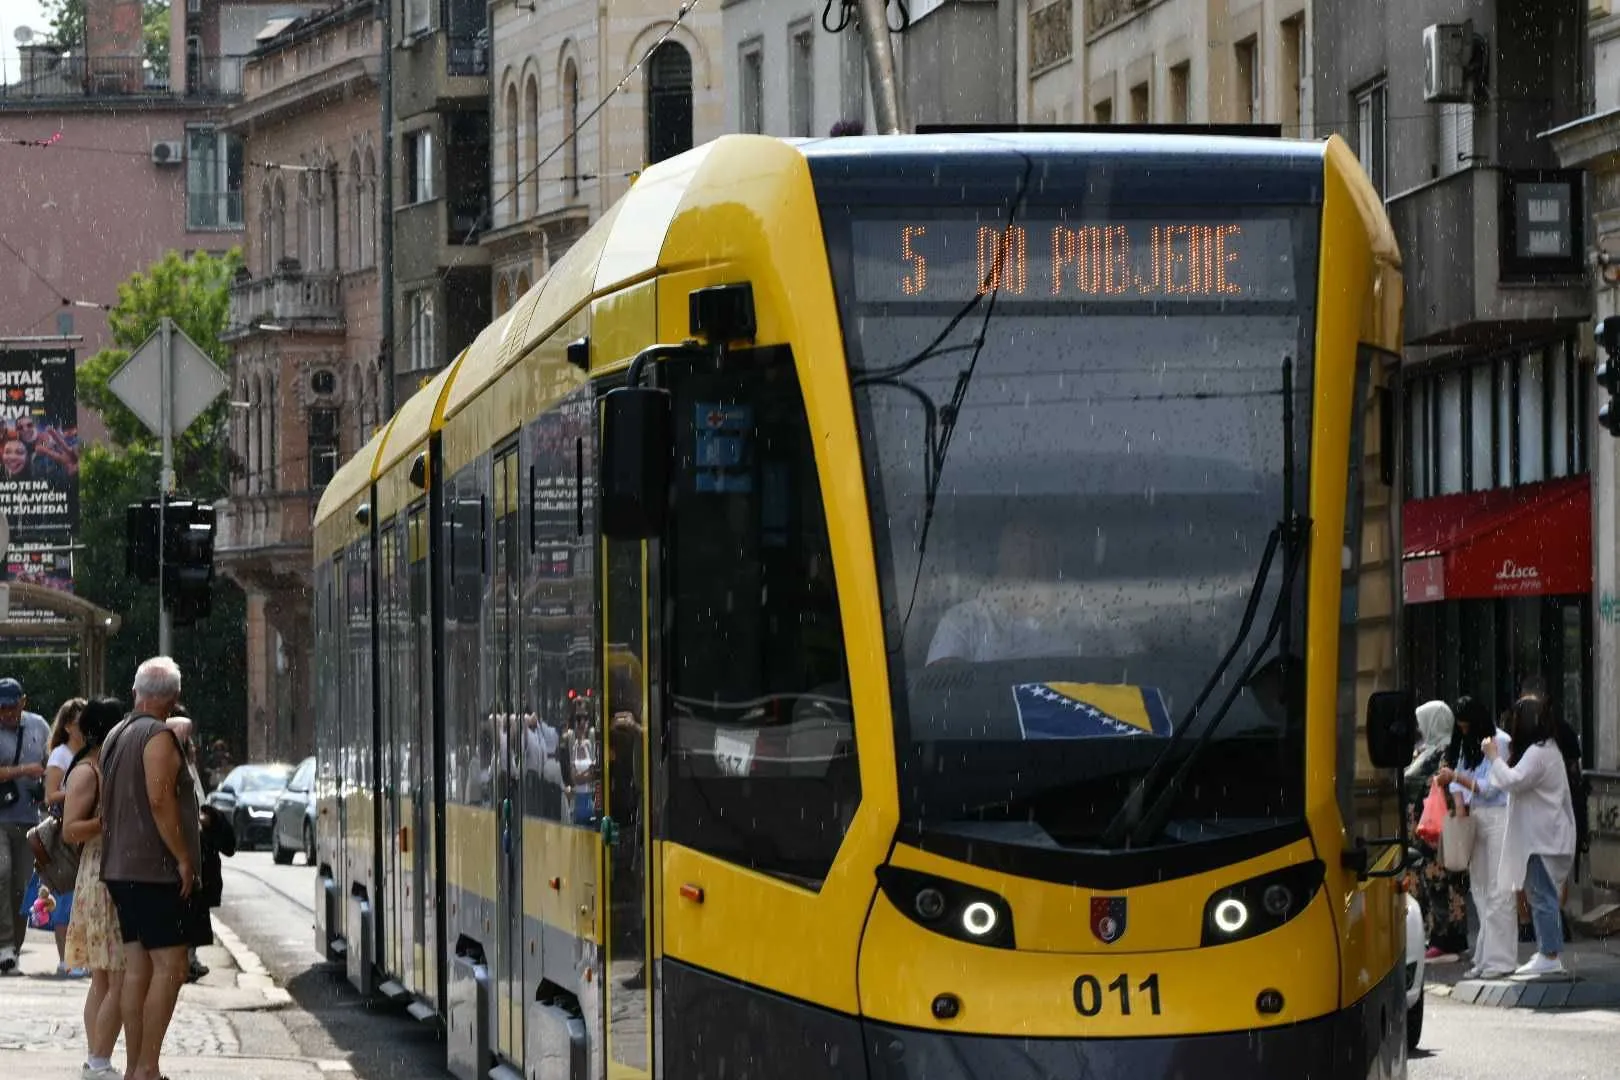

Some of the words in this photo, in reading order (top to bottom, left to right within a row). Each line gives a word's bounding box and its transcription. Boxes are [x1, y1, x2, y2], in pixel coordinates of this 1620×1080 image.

[901, 224, 927, 295] 5
[24, 387, 45, 402] SE
[18, 481, 31, 490] TE
[32, 480, 49, 490] NA
[13, 503, 68, 515] ZVIJEZDA!
[1496, 559, 1538, 579] Lisca
[1073, 972, 1161, 1017] 011
